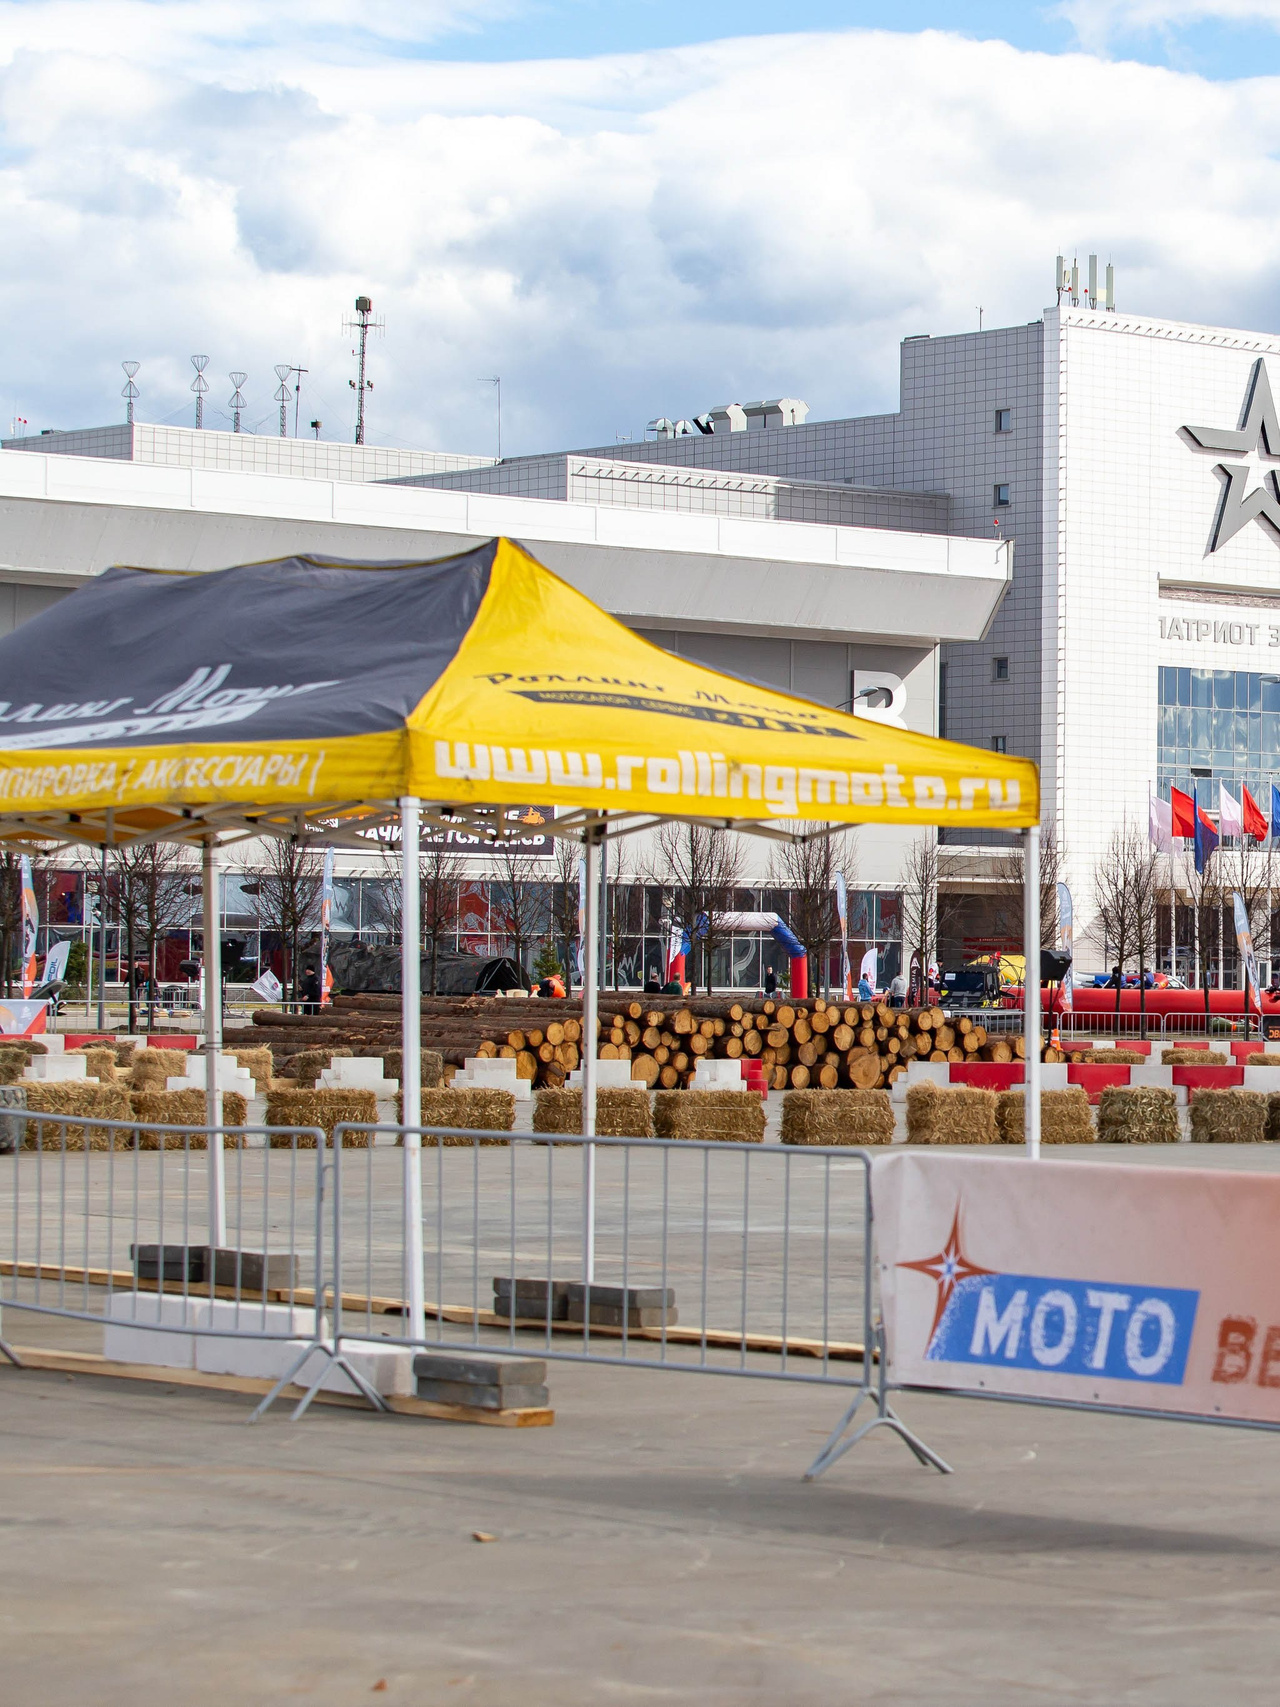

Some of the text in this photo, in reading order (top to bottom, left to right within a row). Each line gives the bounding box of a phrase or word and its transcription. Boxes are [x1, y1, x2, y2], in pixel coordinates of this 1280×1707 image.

[132, 753, 309, 790] АКСЕССУАРЫ
[434, 740, 1021, 817] www.rollingmoto.ru
[969, 1285, 1176, 1377] МОТО
